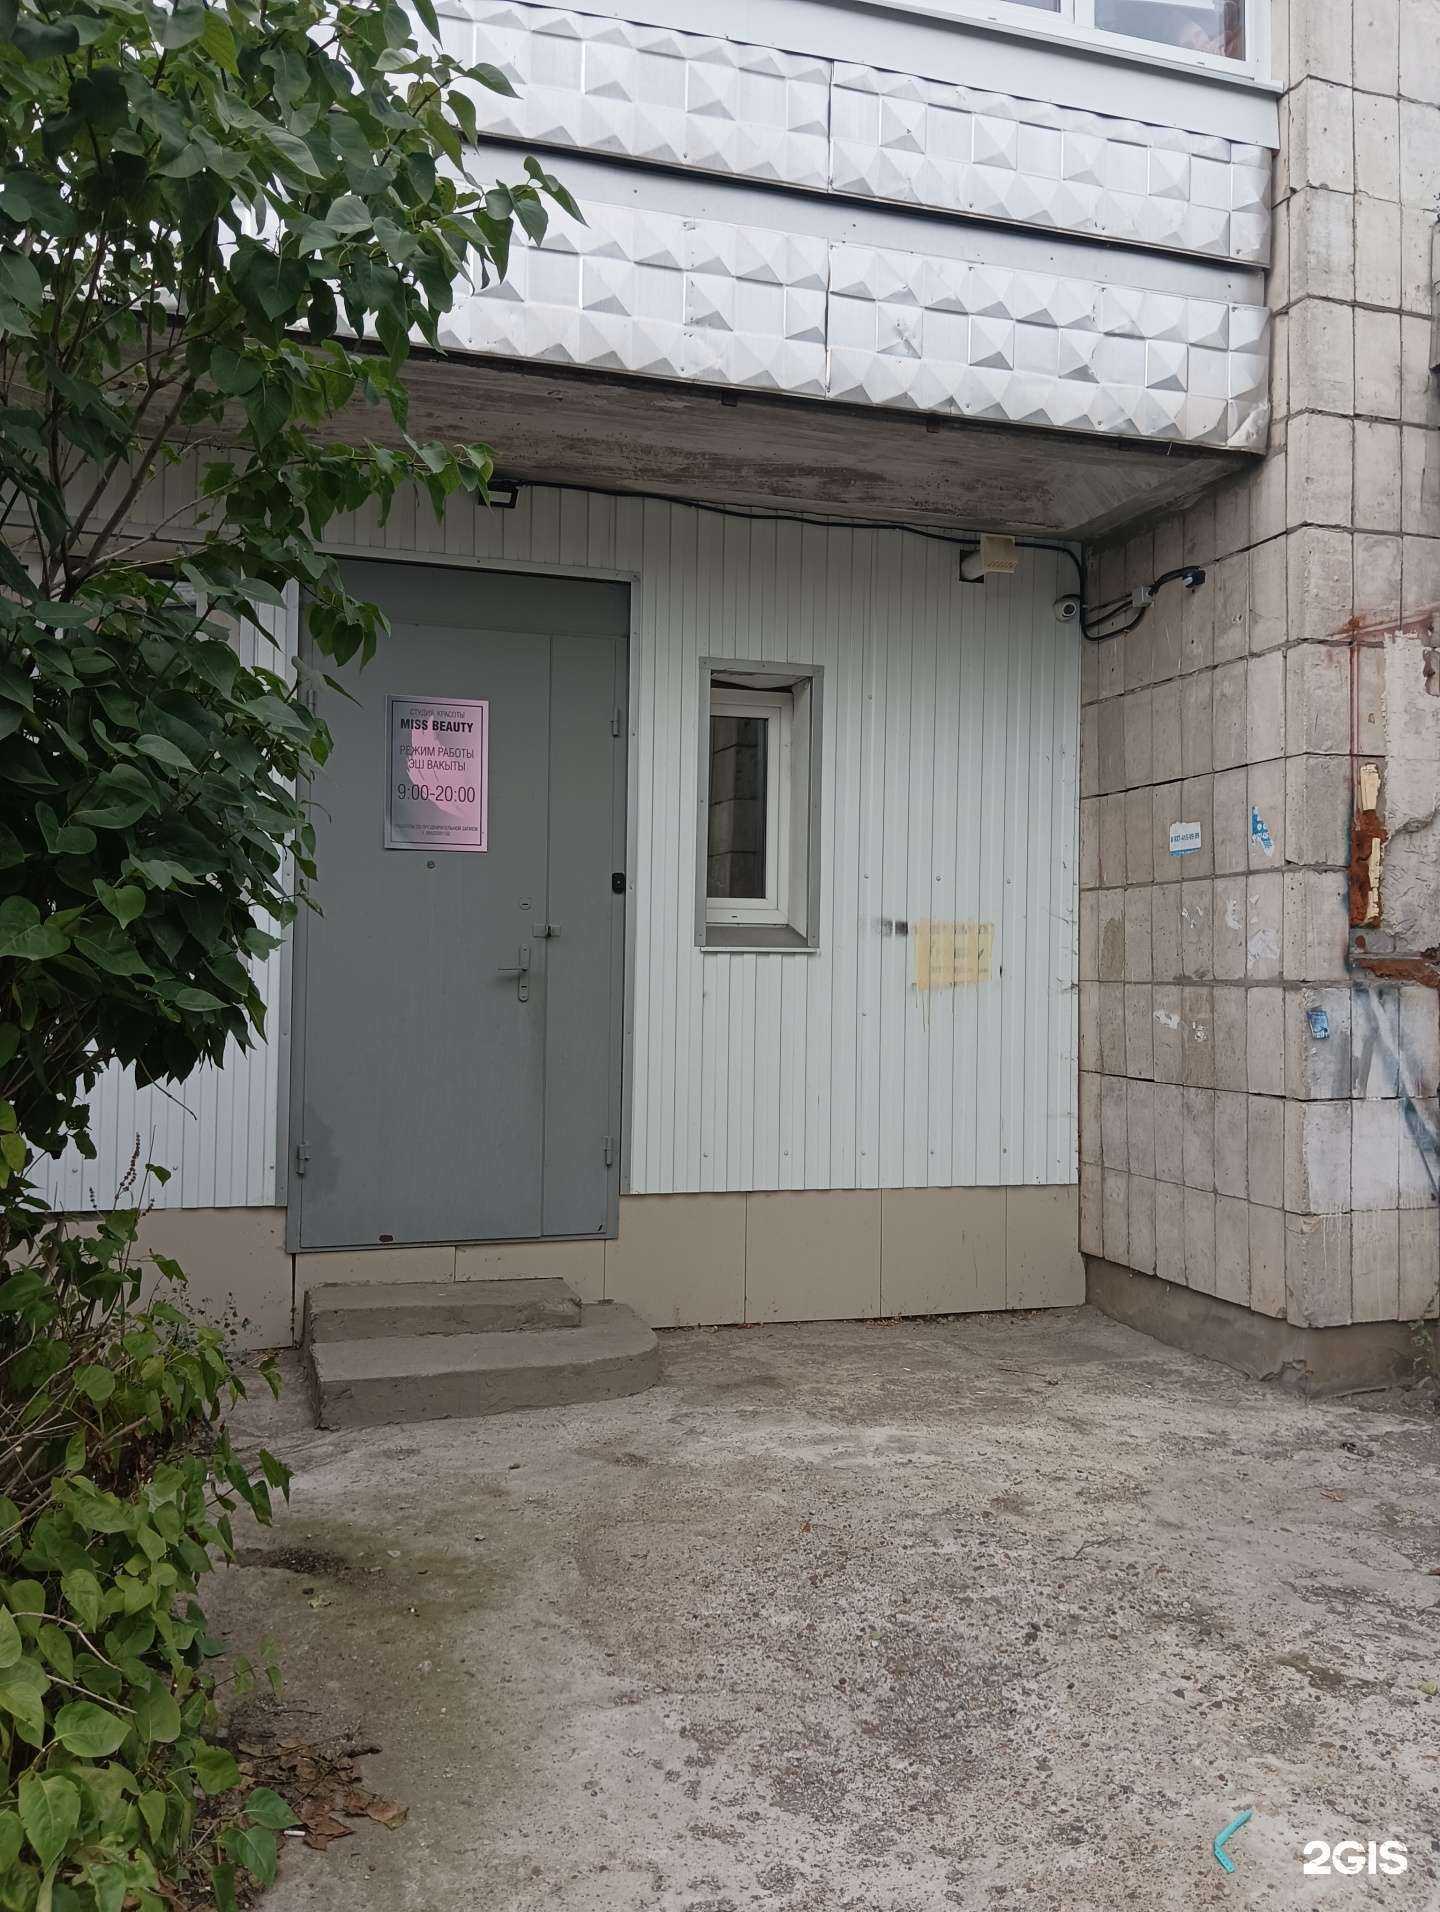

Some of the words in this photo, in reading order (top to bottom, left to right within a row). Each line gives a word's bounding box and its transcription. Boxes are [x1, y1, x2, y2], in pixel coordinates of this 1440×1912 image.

[437, 710, 465, 719] КРАСОТЫ
[400, 718, 429, 731] MISS
[432, 720, 474, 734] BEAUTY
[400, 745, 435, 758] РЕЖИМ
[437, 747, 474, 759] РАБОТЫ
[408, 759, 425, 769] ЭШ
[427, 760, 466, 772] ВАКЫТЫ
[397, 783, 476, 803] 9:00-20:00
